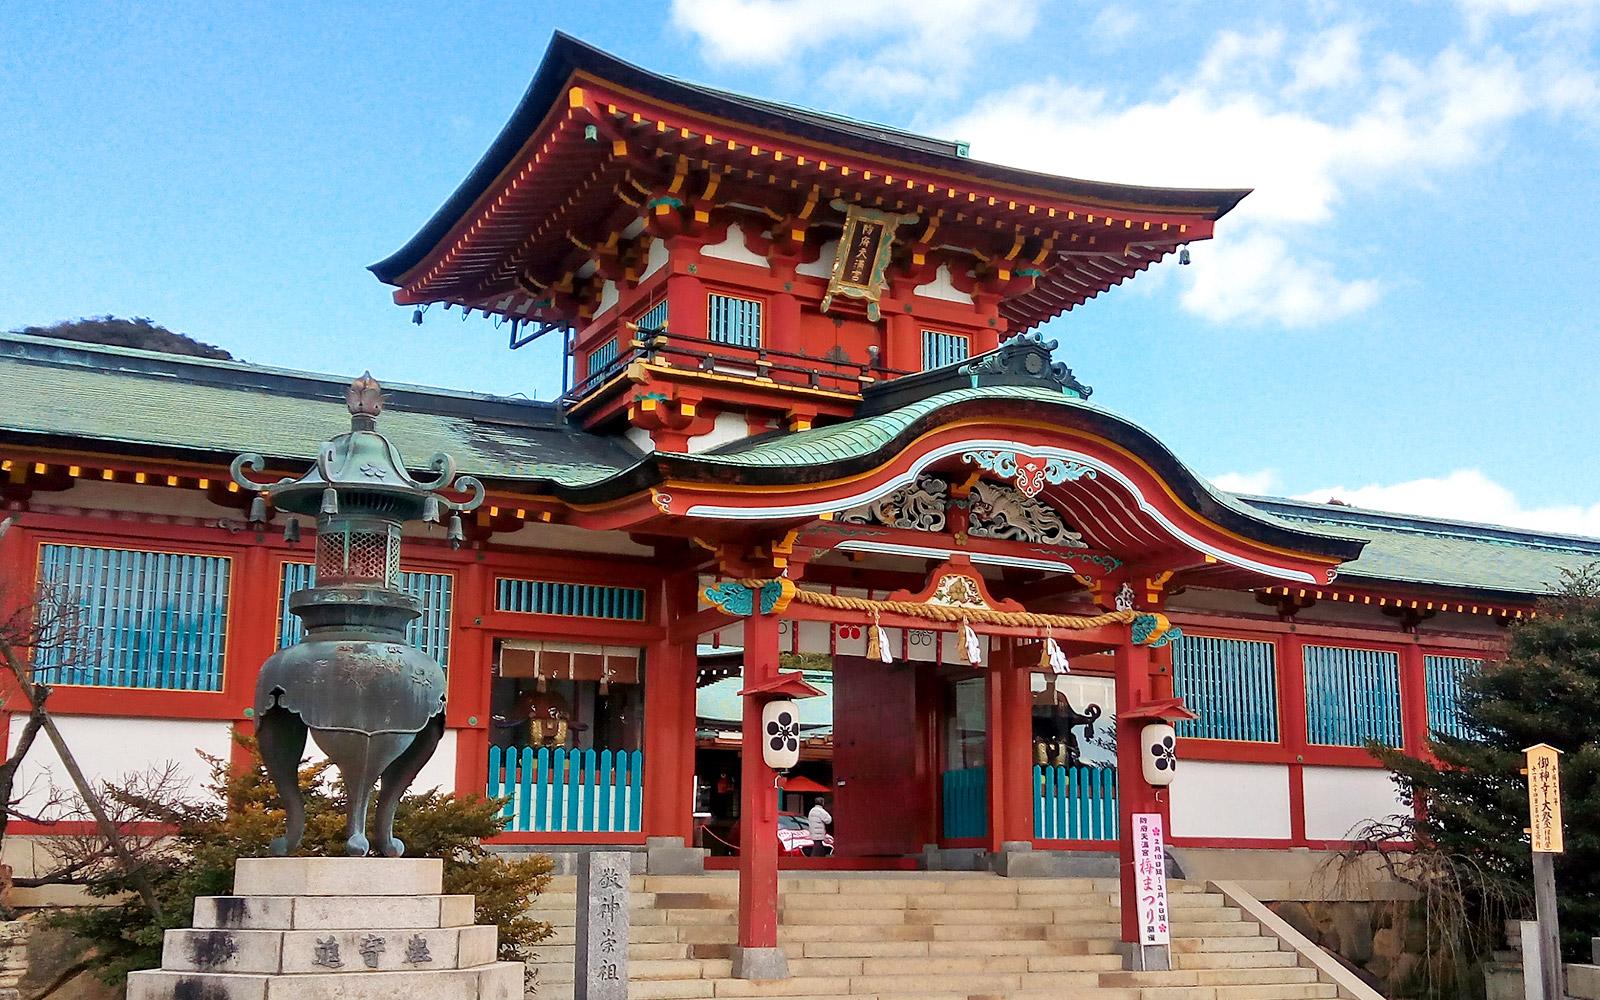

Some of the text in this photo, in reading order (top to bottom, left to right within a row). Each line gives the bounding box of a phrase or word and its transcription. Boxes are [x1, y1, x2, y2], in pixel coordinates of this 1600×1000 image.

[598, 867, 623, 981] 敬神崇祖
[1140, 858, 1155, 924] 梅まつり
